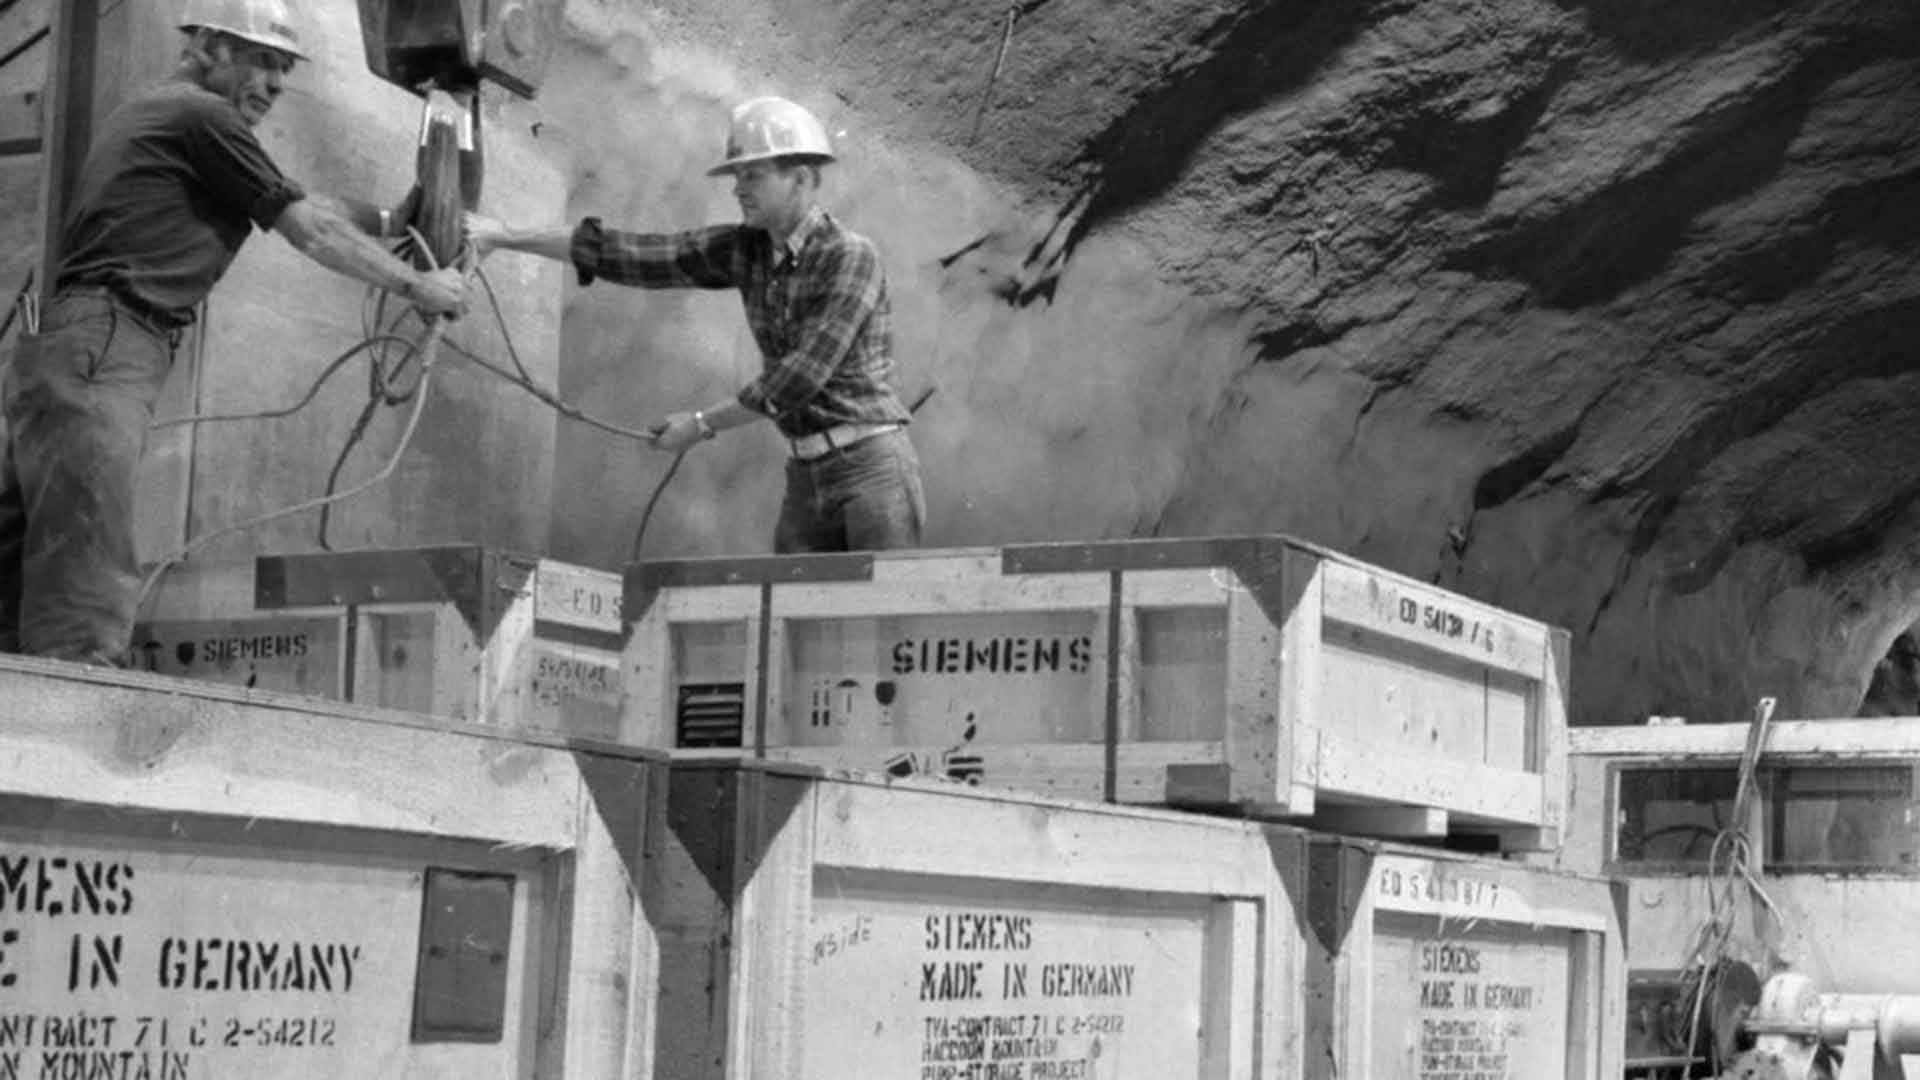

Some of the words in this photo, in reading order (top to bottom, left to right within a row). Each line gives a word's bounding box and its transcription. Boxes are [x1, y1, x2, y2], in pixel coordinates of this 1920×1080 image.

[203, 632, 308, 663] SIEMENS
[892, 636, 1092, 675] SIEMENS
[925, 914, 1032, 951] SIEMENS
[68, 932, 123, 993] IN
[158, 937, 361, 992] GERMANY
[1422, 946, 1481, 974] SIEMENS
[919, 961, 984, 1001] MADE
[1003, 963, 1027, 1001] IN
[1041, 963, 1135, 998] GERMANY
[1420, 980, 1455, 1009] MADE
[1464, 982, 1478, 1008] IN
[1484, 983, 1533, 1009] GERMANY
[189, 1016, 207, 1047] C
[223, 1016, 337, 1047] 2-54212
[924, 1015, 1026, 1038] TVA-CONTRACT
[40, 1050, 189, 1080] MOUNTAIN
[921, 1037, 985, 1062] RACCOON
